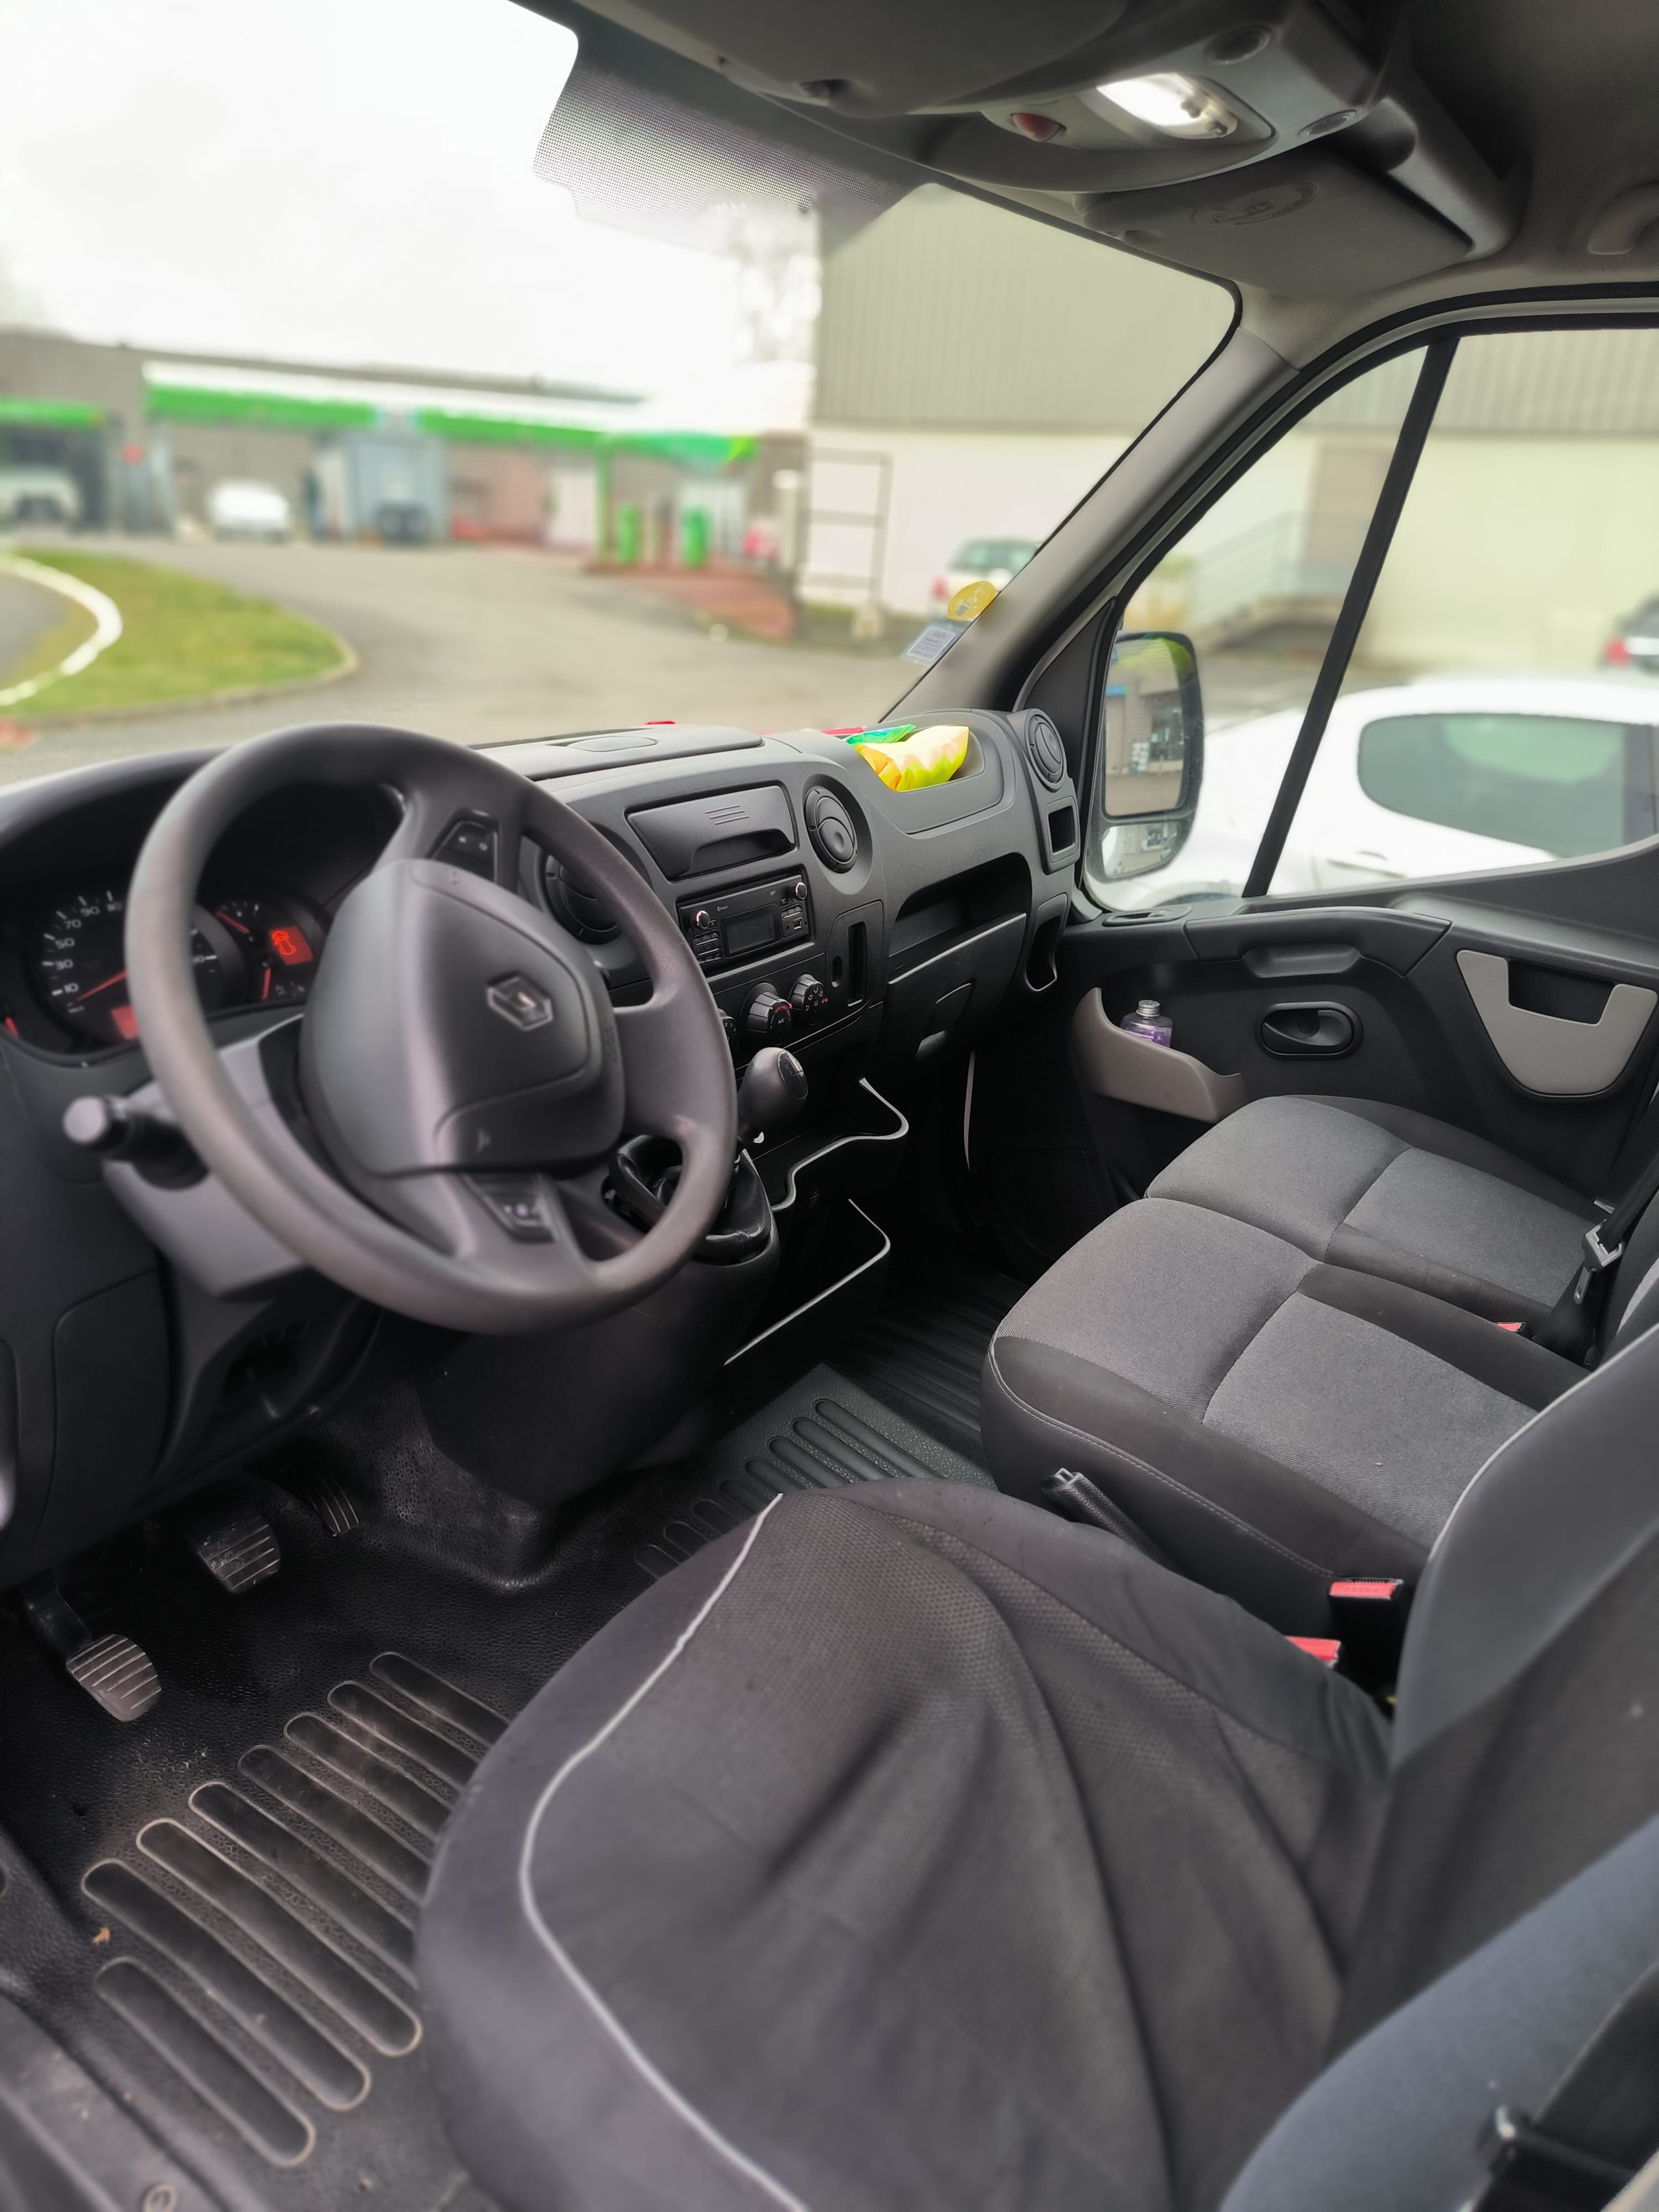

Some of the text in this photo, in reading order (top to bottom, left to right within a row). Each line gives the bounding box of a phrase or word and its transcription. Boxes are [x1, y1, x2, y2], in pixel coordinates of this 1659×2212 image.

[81, 906, 100, 917] 90
[64, 919, 82, 930] 70
[55, 937, 75, 948] 50
[54, 959, 74, 970] 30
[64, 982, 79, 993] 10
